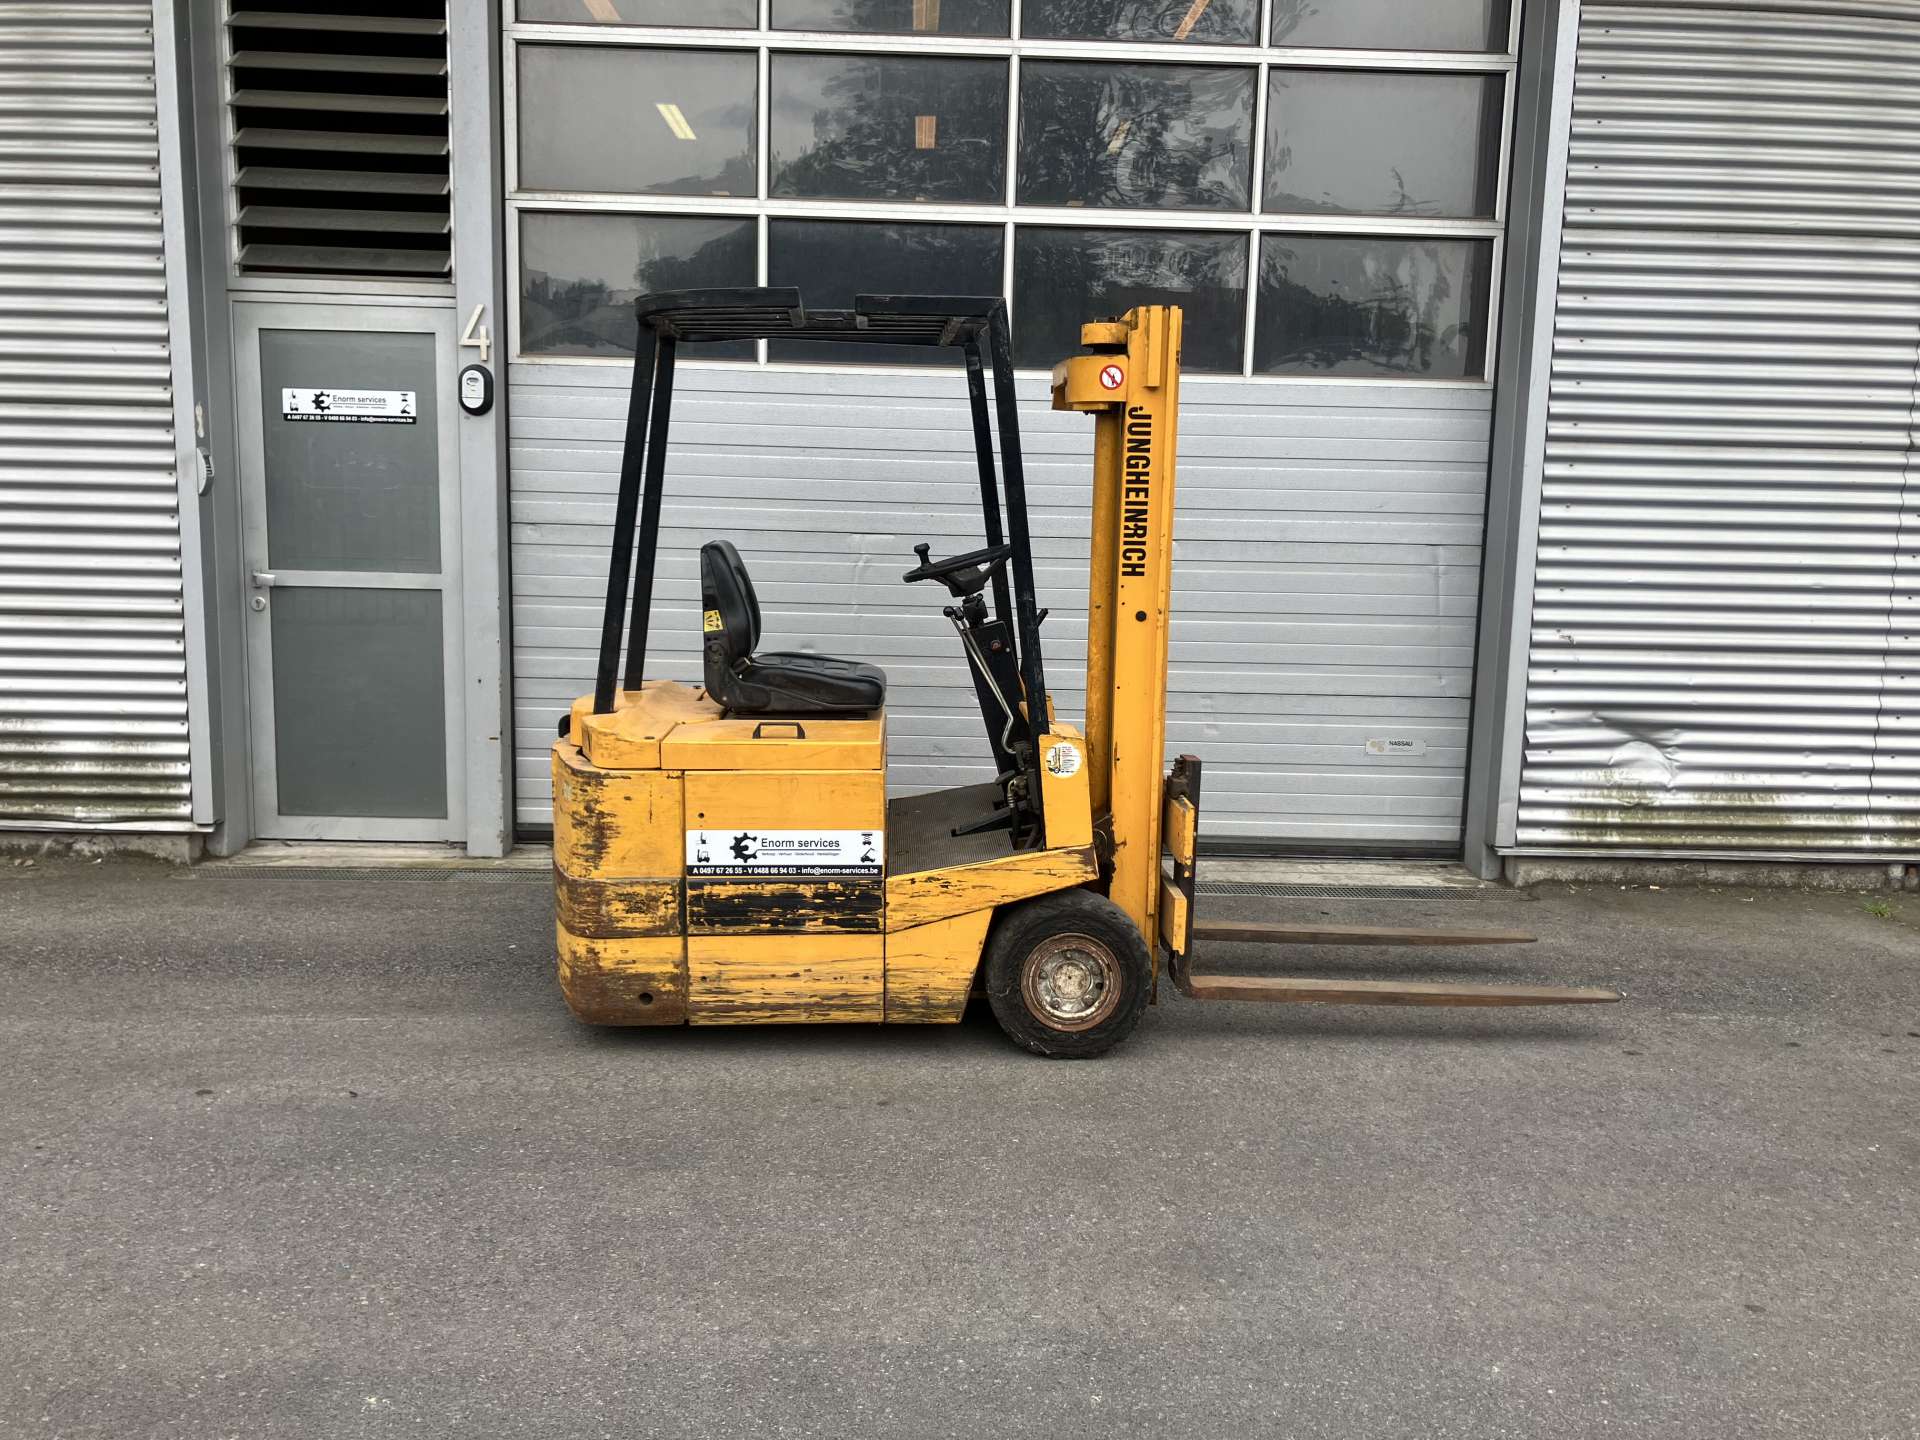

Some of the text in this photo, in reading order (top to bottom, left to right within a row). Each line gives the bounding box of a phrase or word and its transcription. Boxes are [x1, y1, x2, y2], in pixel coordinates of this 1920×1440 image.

[458, 303, 491, 361] 4
[332, 394, 386, 404] Enorm services
[1121, 405, 1152, 577] JUNGHEINRICH
[761, 837, 840, 848] Enorm services
[801, 866, 879, 876] info@enorm-services.be
